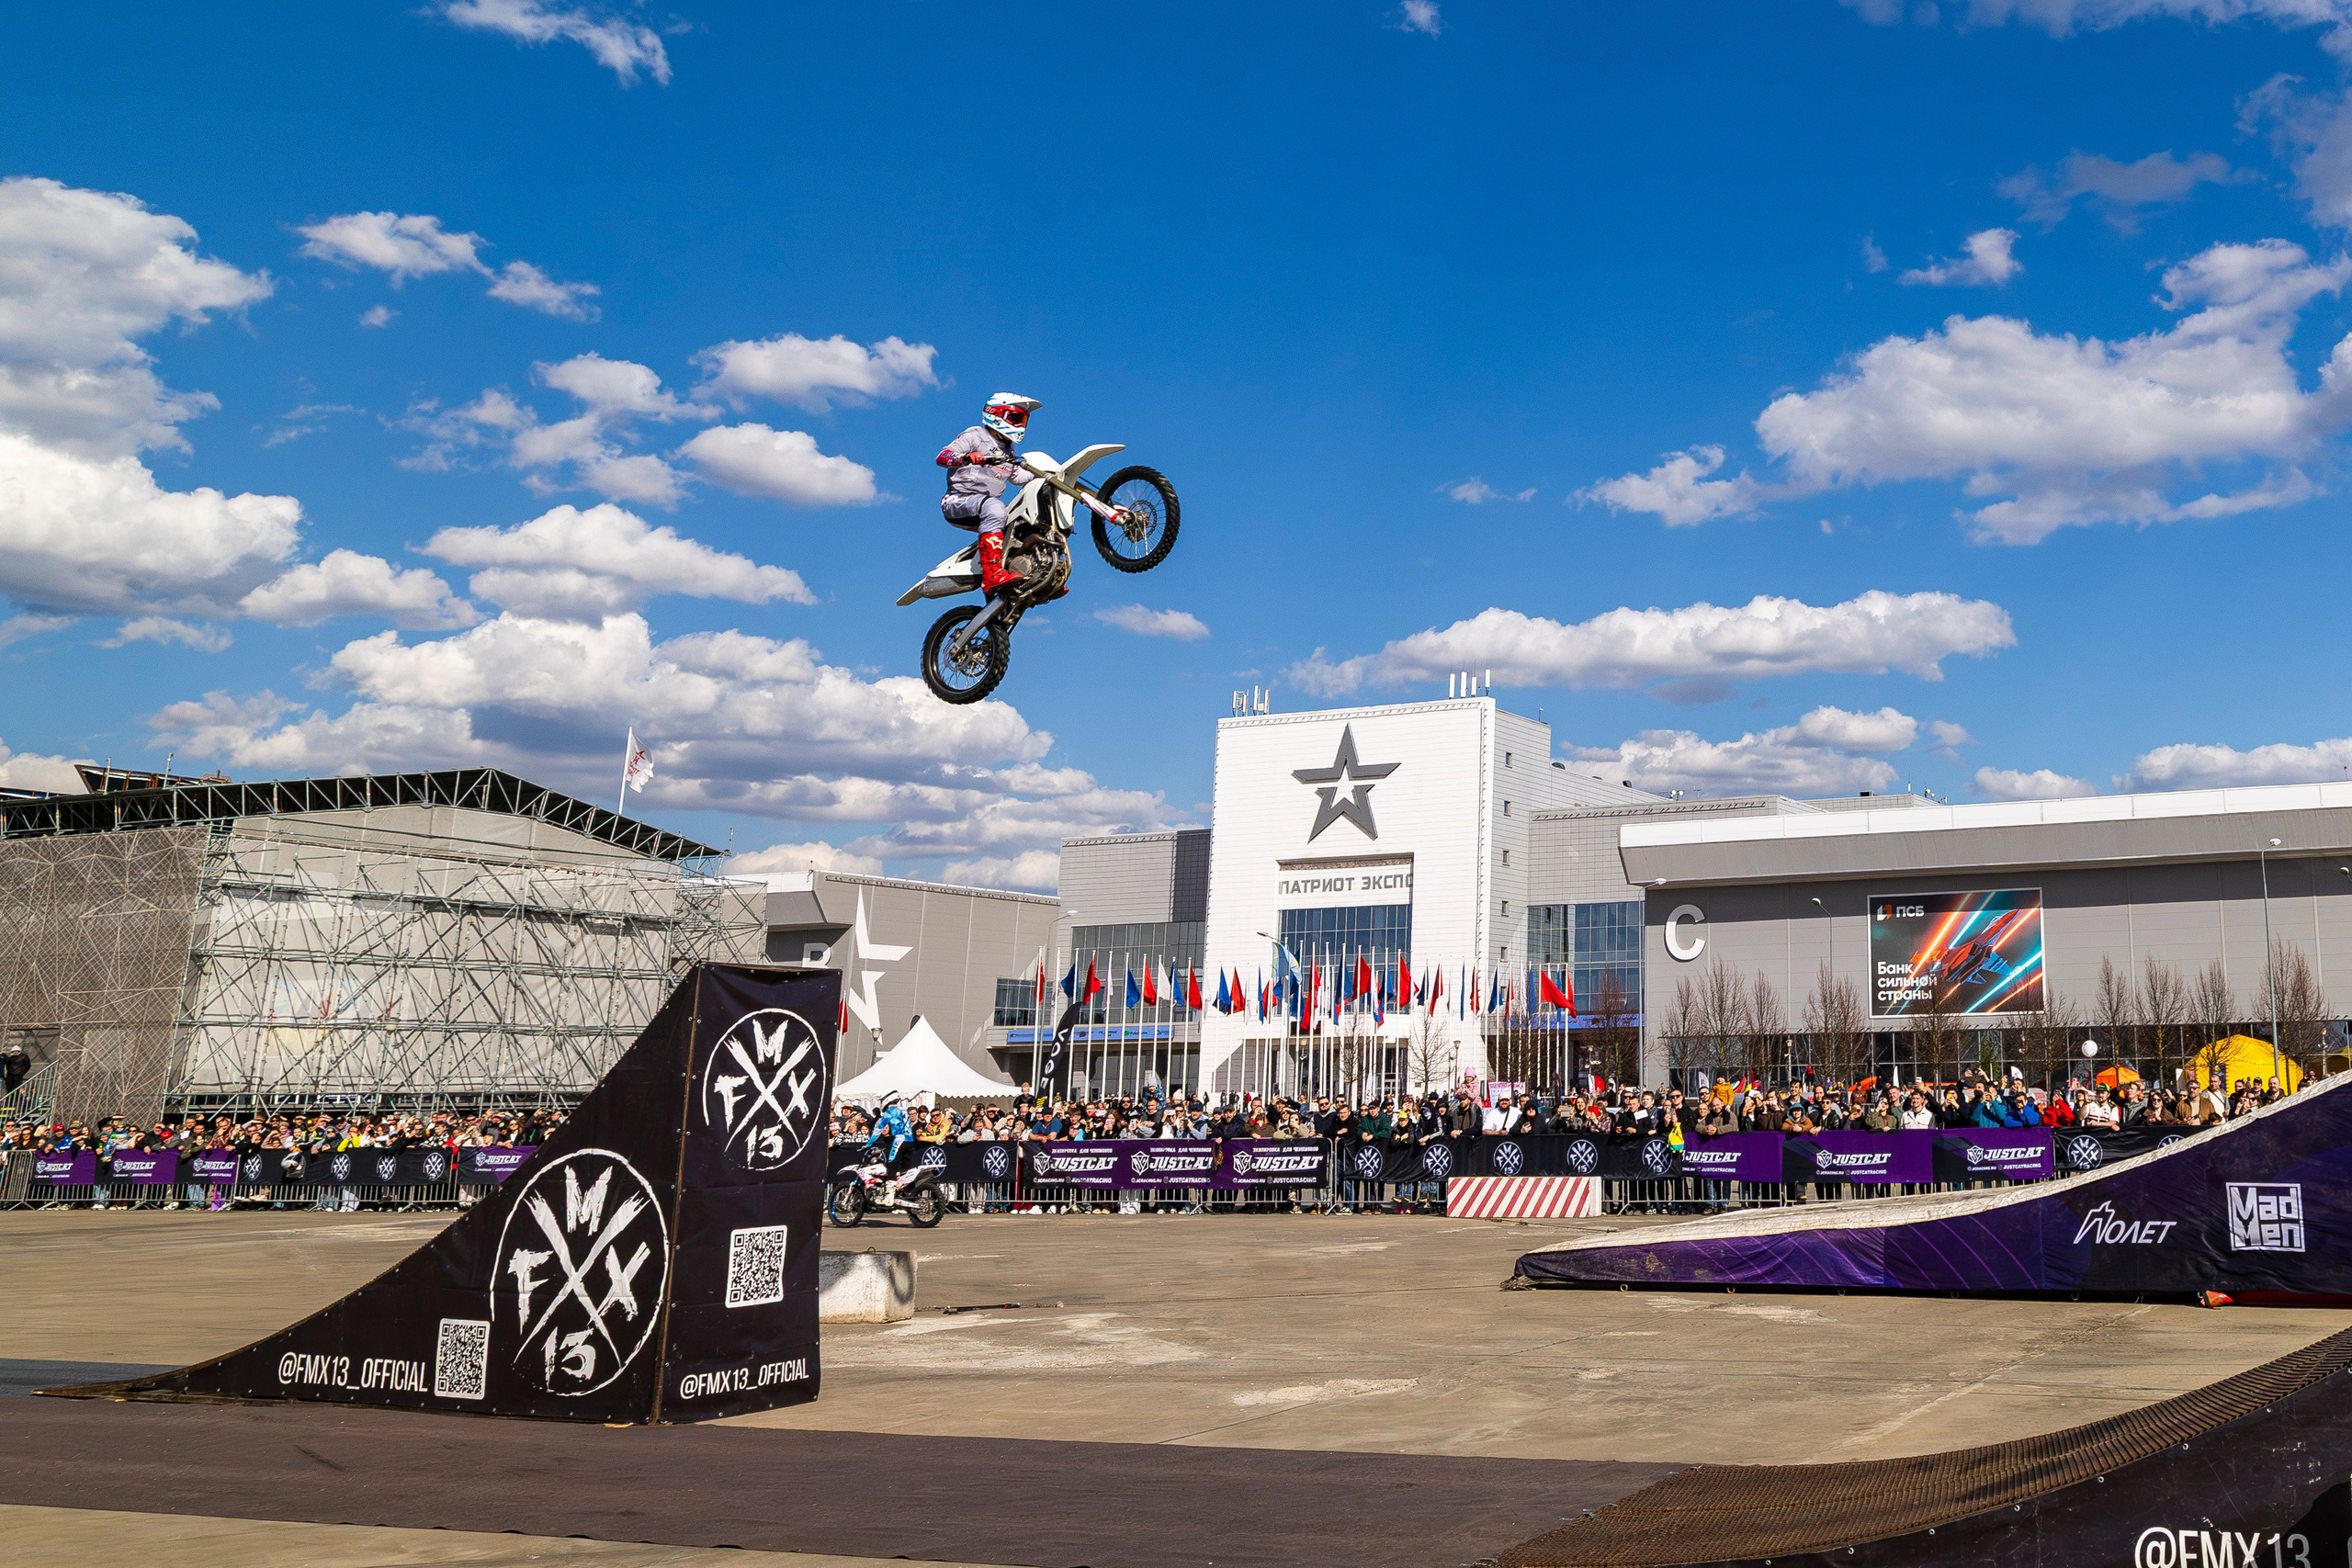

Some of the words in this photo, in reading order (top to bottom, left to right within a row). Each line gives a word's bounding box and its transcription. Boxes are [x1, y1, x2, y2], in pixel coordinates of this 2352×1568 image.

[1278, 877, 1354, 895] ПАТРИОТ
[1362, 874, 1413, 890] ЭКСПО
[1896, 906, 1925, 918] ПСБ
[1878, 961, 1914, 975] Банк
[1878, 974, 1938, 987] сильной
[1878, 990, 1932, 1004] страны
[1040, 1028, 1069, 1089] VOGE
[745, 1124, 783, 1167] 13
[484, 1155, 522, 1165] JUSTCAT
[1685, 1152, 1741, 1163] JUSTCAT
[1832, 1153, 1892, 1166] JUSTCAT
[1984, 1147, 2046, 1161] JUSTCAT
[122, 1161, 156, 1170] JUSTCAT
[202, 1161, 235, 1169] JUSTCAT
[1050, 1156, 1118, 1171] JUSTCAT
[1149, 1156, 1213, 1171] JUSTCAT
[1251, 1156, 1323, 1171] JUSTCAT
[2230, 1187, 2299, 1220] Mad
[2233, 1218, 2301, 1247] Men
[544, 1325, 596, 1385] 13
[278, 1351, 428, 1393] @FMX13_OFFICIAL
[680, 1358, 809, 1400] @FMX13_OFFICIAL
[2134, 1526, 2311, 1568] @FMX13
